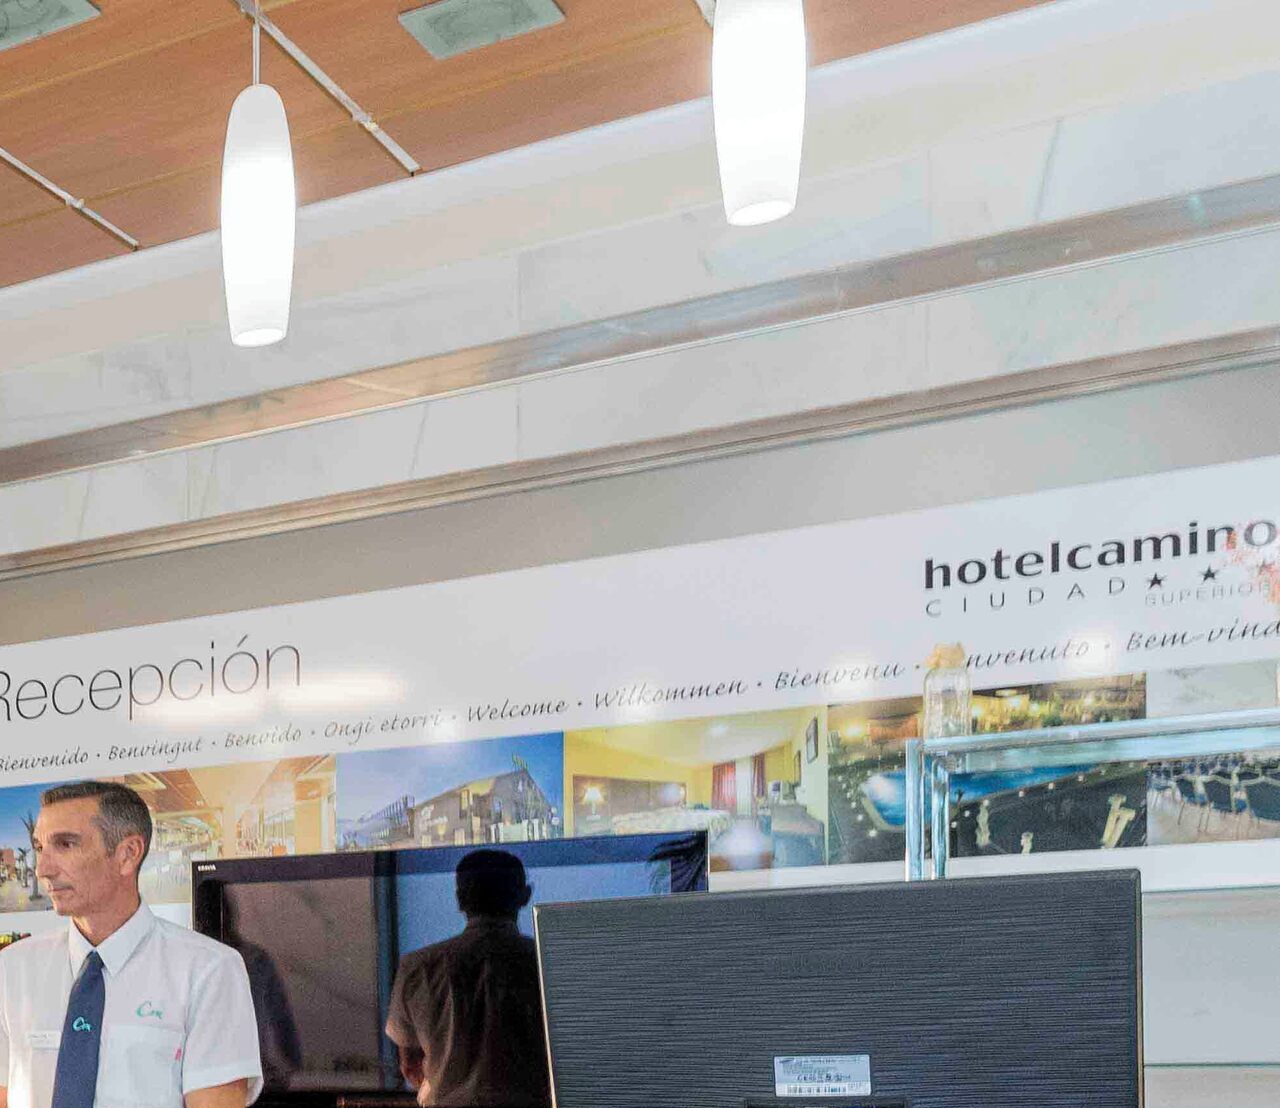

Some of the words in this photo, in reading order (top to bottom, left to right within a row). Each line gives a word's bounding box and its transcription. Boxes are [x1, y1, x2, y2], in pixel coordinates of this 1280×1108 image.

[924, 519, 1278, 589] hotelcamino
[925, 577, 1126, 618] CIUDAD
[107, 736, 202, 764] Benvingut
[324, 715, 374, 746] Ongi
[468, 697, 568, 722] Welcome
[775, 658, 906, 692] Bienvenu
[964, 640, 1091, 670] nvenuto
